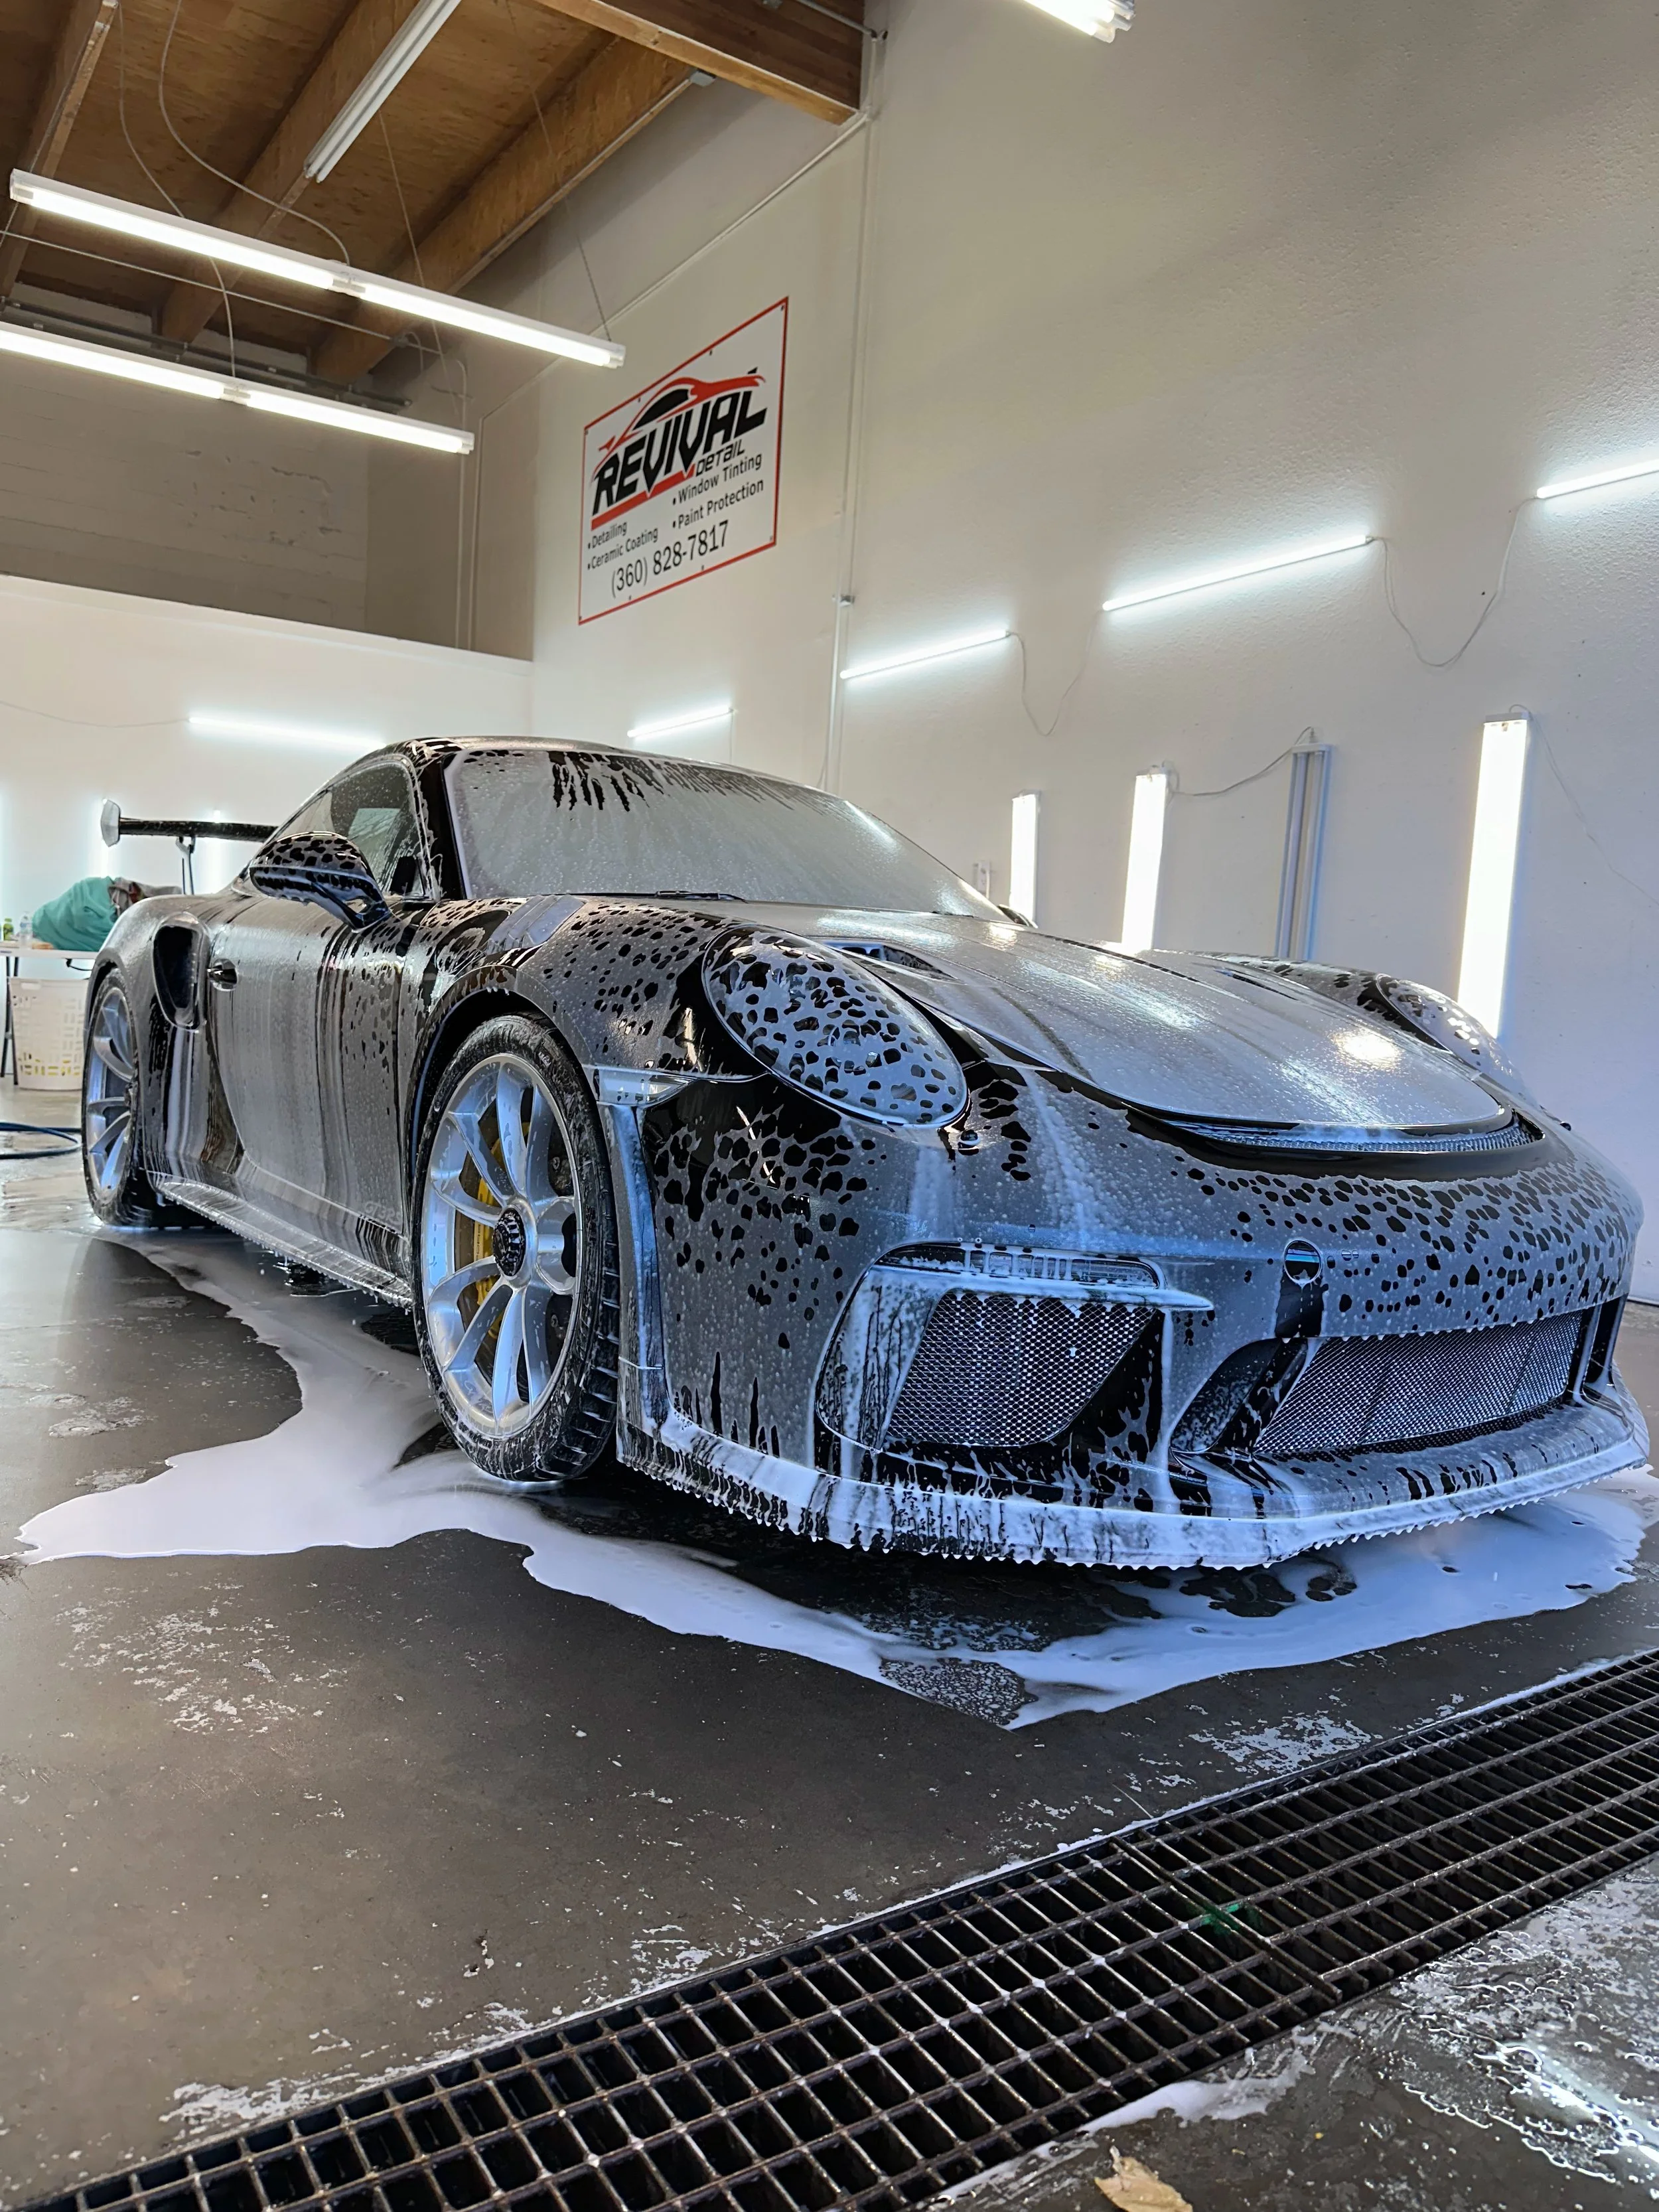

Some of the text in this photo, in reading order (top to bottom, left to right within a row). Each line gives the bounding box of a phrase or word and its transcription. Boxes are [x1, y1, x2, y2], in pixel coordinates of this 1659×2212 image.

[593, 391, 767, 516] REVIVAL
[678, 454, 762, 504] Window Tinting
[678, 480, 764, 529] Paint Protection
[591, 528, 658, 569] Ceramic Coating
[592, 522, 627, 548] Detailing
[611, 519, 729, 599] (360) 828-7817
